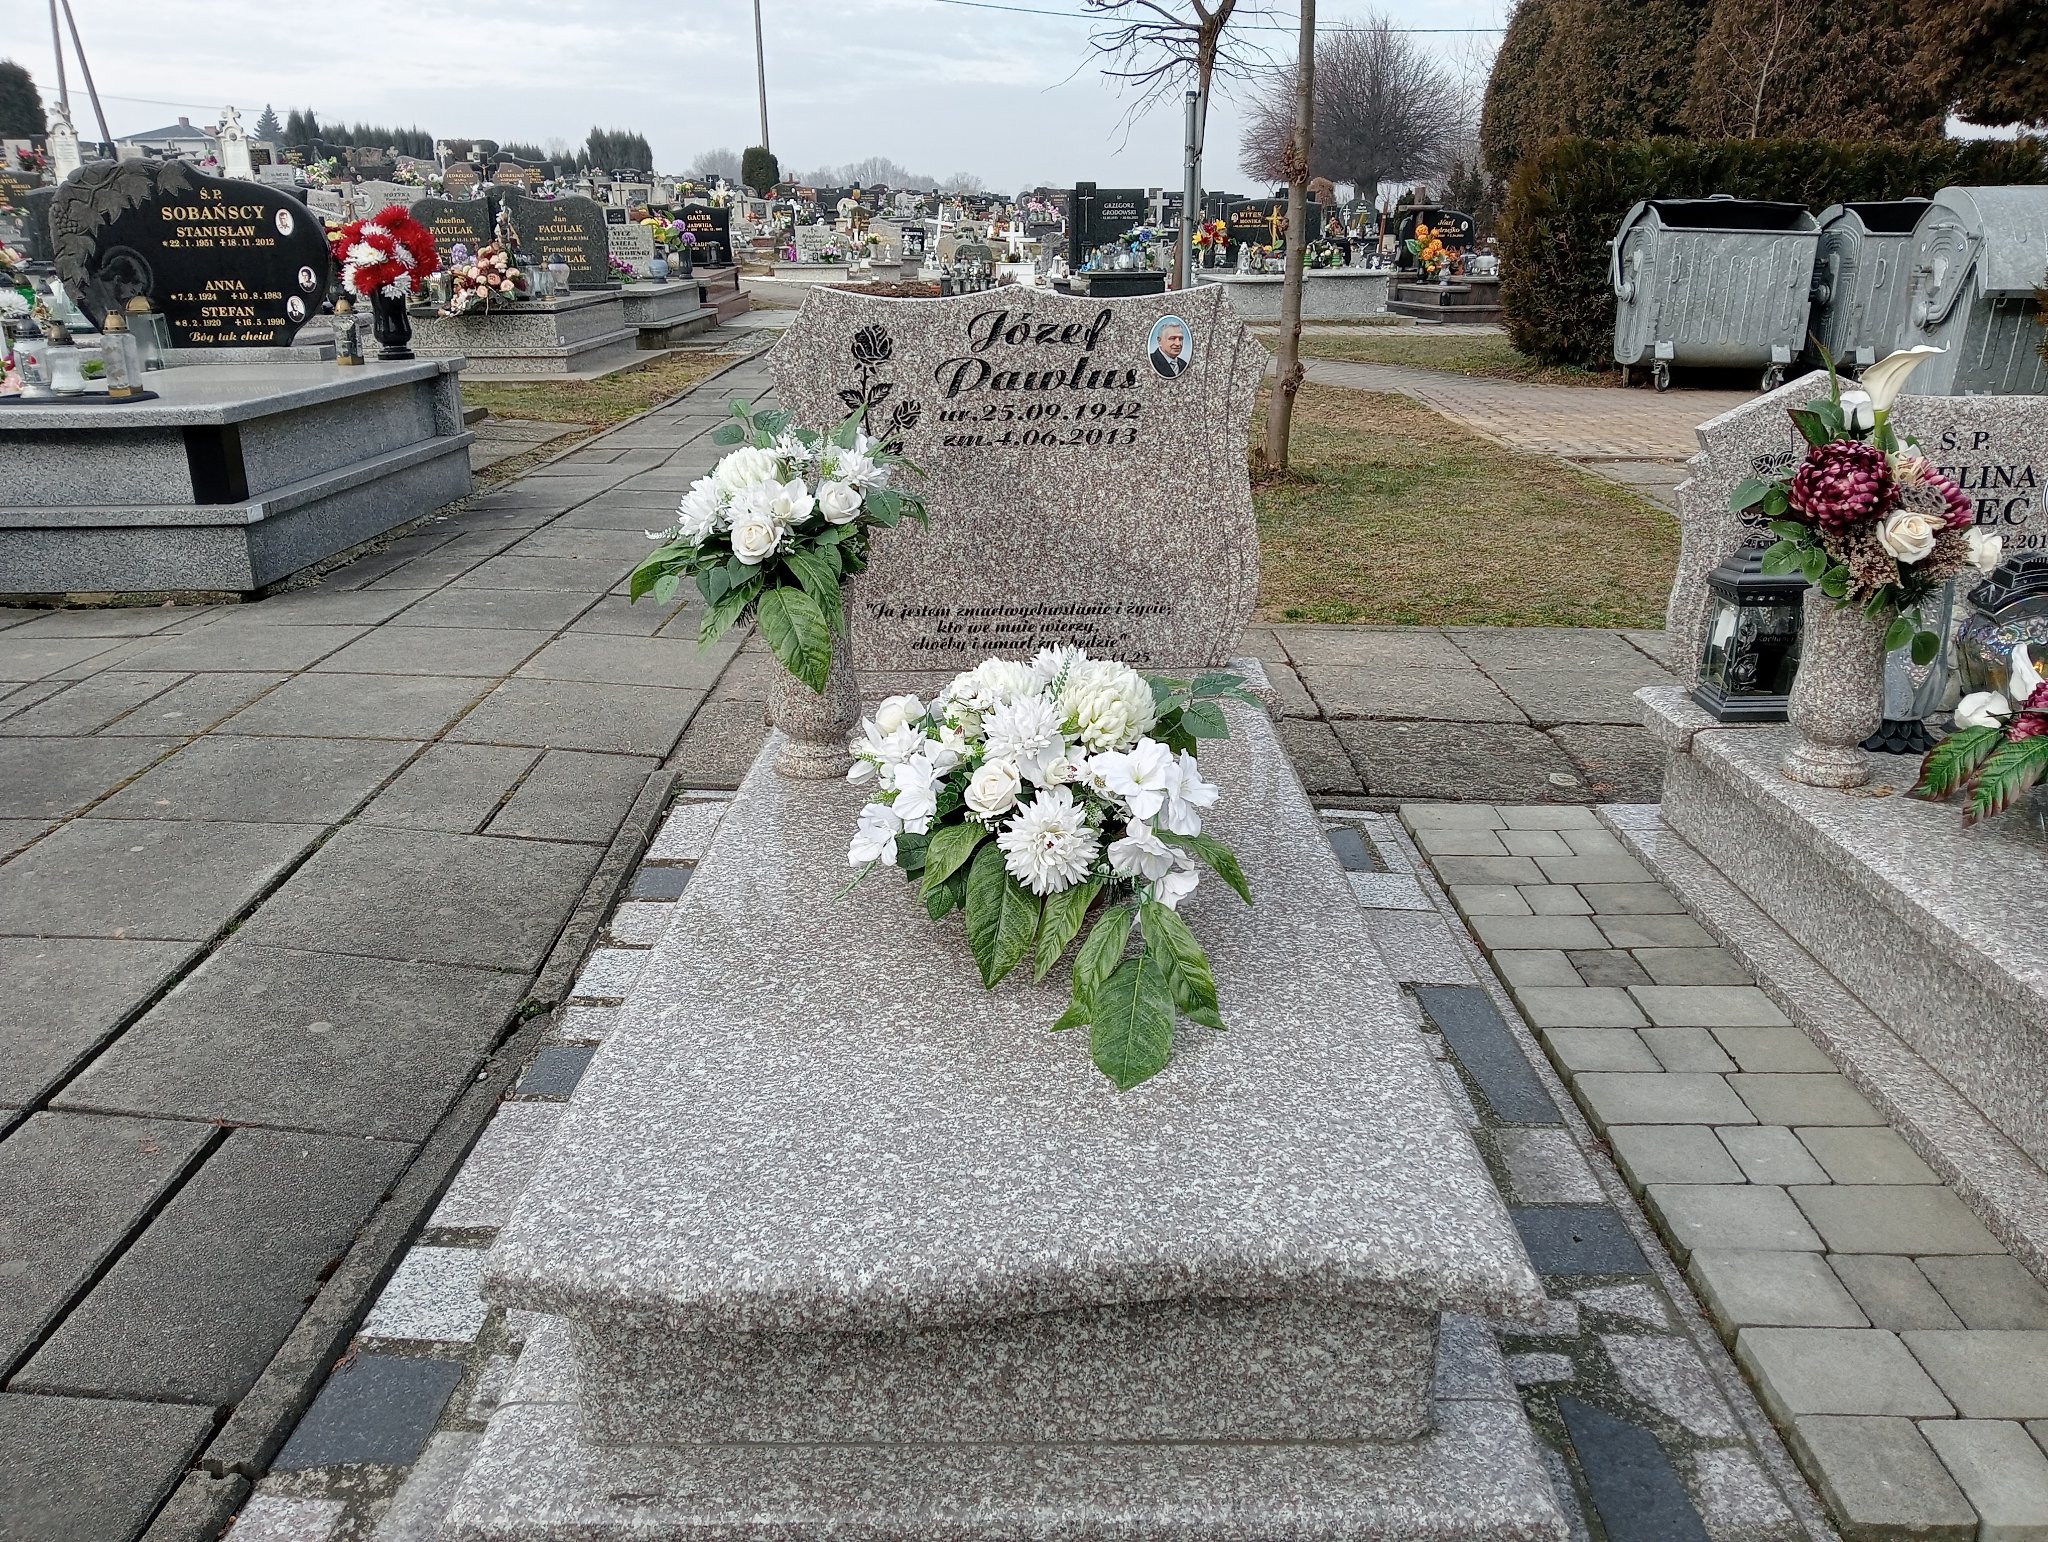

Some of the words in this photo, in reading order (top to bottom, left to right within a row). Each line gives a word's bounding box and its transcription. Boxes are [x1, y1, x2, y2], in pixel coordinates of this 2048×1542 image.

[161, 202, 265, 221] SOBAŃSCY
[176, 225, 256, 238] STANISŁAW
[429, 226, 473, 235] FACULAK
[538, 224, 583, 233] FACULAK
[543, 245, 583, 253] Franciszek
[204, 279, 245, 291] ANNA
[201, 306, 255, 317] STEFAN
[189, 331, 214, 343] Bóg
[968, 308, 1112, 353] Józef
[1937, 464, 2038, 489] ELINA
[1971, 490, 2030, 526] EĆ
[2001, 534, 2048, 549] 2.201
[900, 604, 951, 621] jestem
[956, 602, 1112, 618] zmartwychwstanie
[1115, 601, 1122, 615] i
[936, 620, 963, 634] kto
[967, 625, 991, 634] we
[995, 619, 1037, 633] mnie
[971, 637, 979, 650] i
